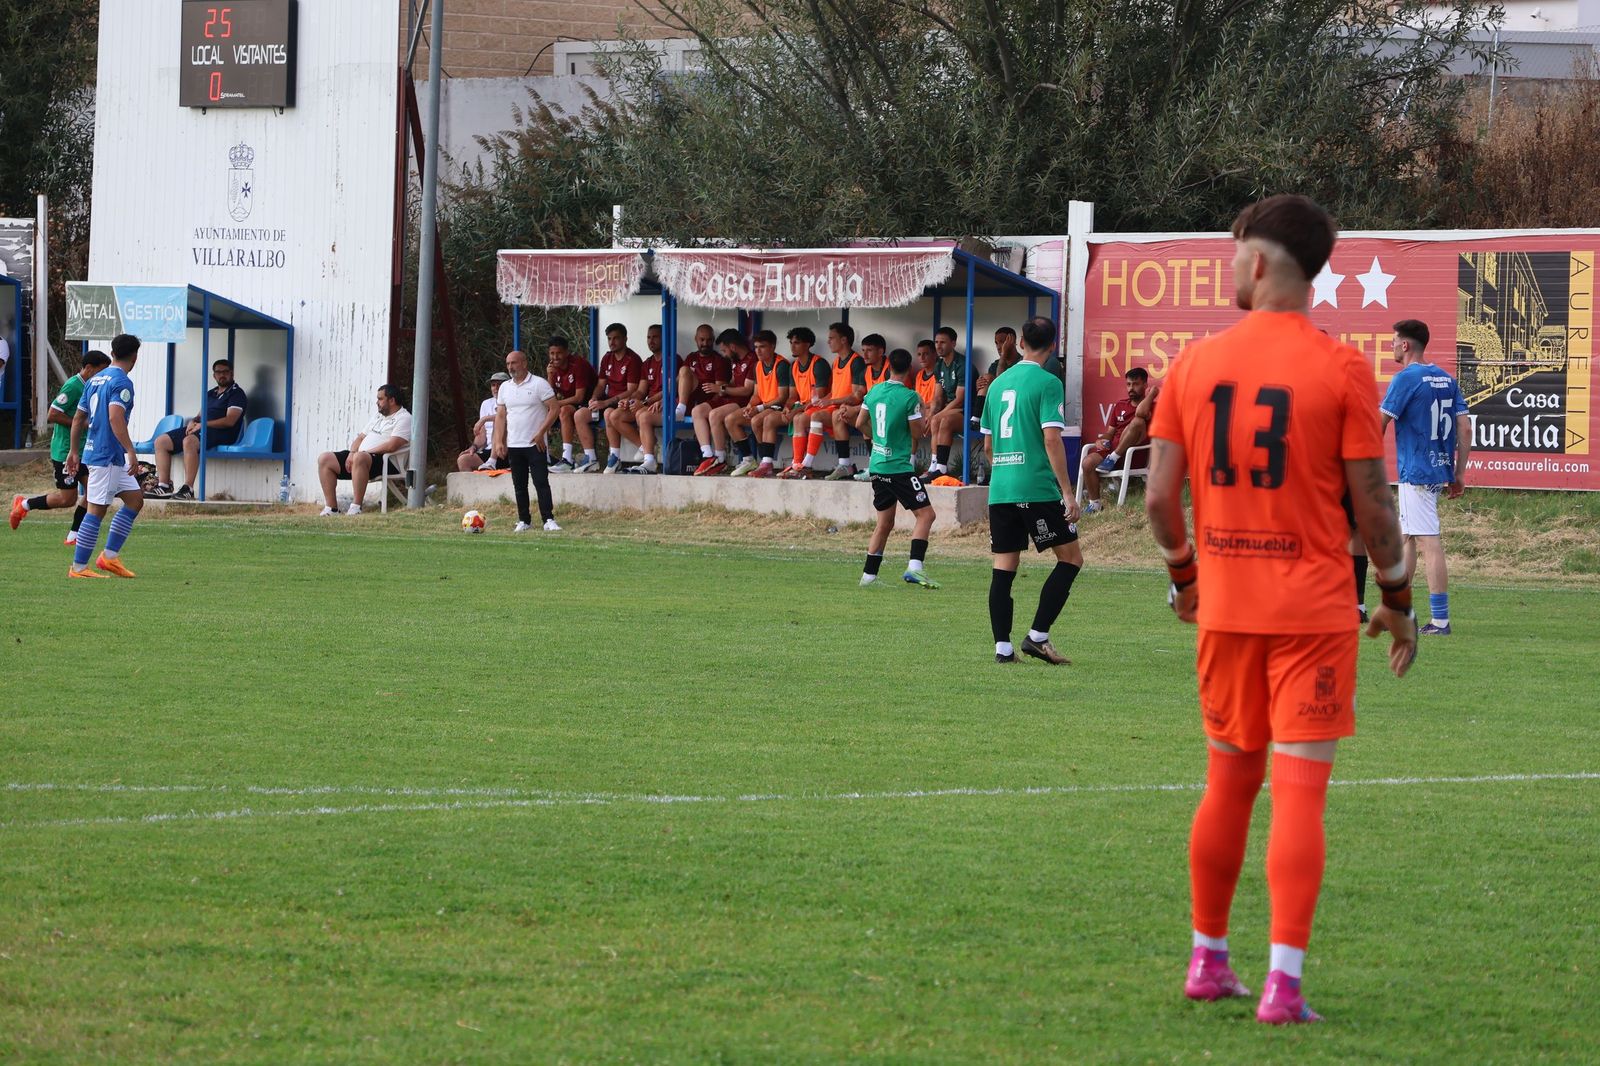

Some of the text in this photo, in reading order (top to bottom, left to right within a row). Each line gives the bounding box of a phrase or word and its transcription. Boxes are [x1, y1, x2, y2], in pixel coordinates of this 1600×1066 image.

[204, 8, 232, 38] 25
[191, 44, 287, 65] LOCAL VISITANTES
[209, 71, 221, 101] 0
[193, 227, 286, 242] AYUNTAMIENTO DE
[192, 247, 286, 268] VILLARALBO
[585, 264, 627, 281] HOTEL
[686, 262, 864, 302] Casa Aurelia
[1102, 259, 1230, 307] HOTEL
[68, 299, 184, 321] METAL GESTIÓN
[1566, 256, 1590, 449] AURELIA
[1506, 387, 1560, 409] Casa
[875, 402, 887, 438] 8
[1000, 389, 1017, 439] 2
[1430, 398, 1453, 441] 15
[1210, 381, 1294, 490] 13
[1454, 457, 1590, 473] ww.casaaurelia.com
[910, 476, 922, 491] 8
